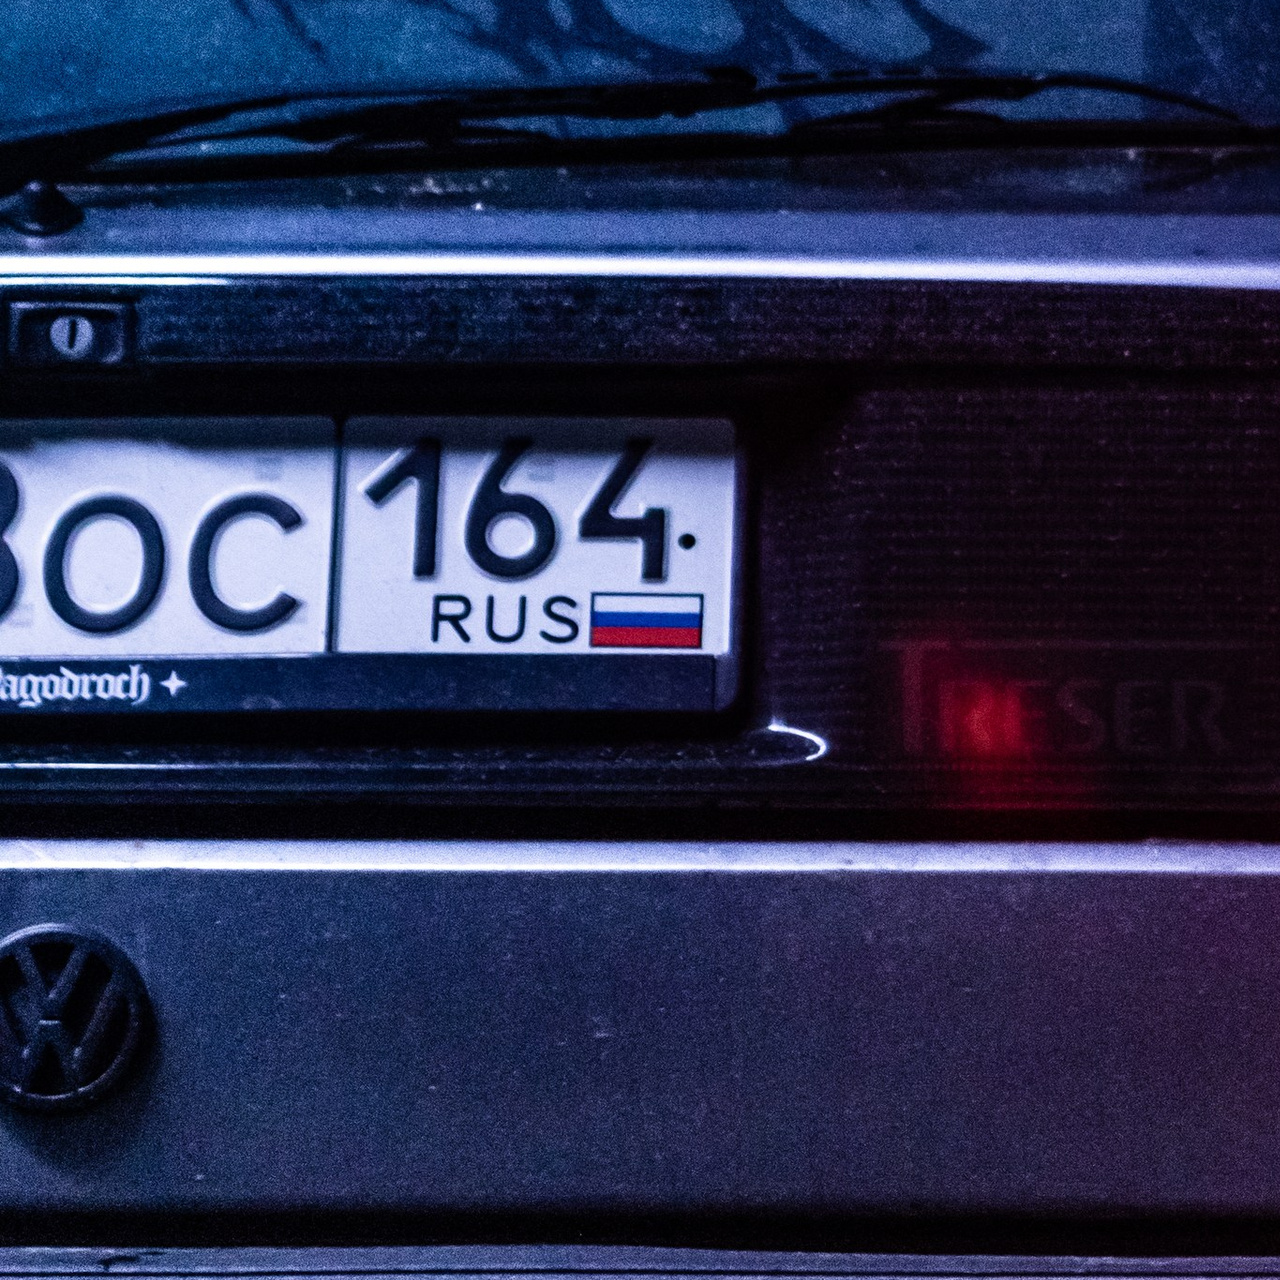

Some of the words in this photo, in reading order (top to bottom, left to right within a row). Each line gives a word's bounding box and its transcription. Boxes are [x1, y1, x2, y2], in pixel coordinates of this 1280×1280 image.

[0, 453, 304, 634] OC
[361, 436, 668, 582] 164
[431, 595, 580, 645] RUS
[0, 664, 150, 708] agodroch
